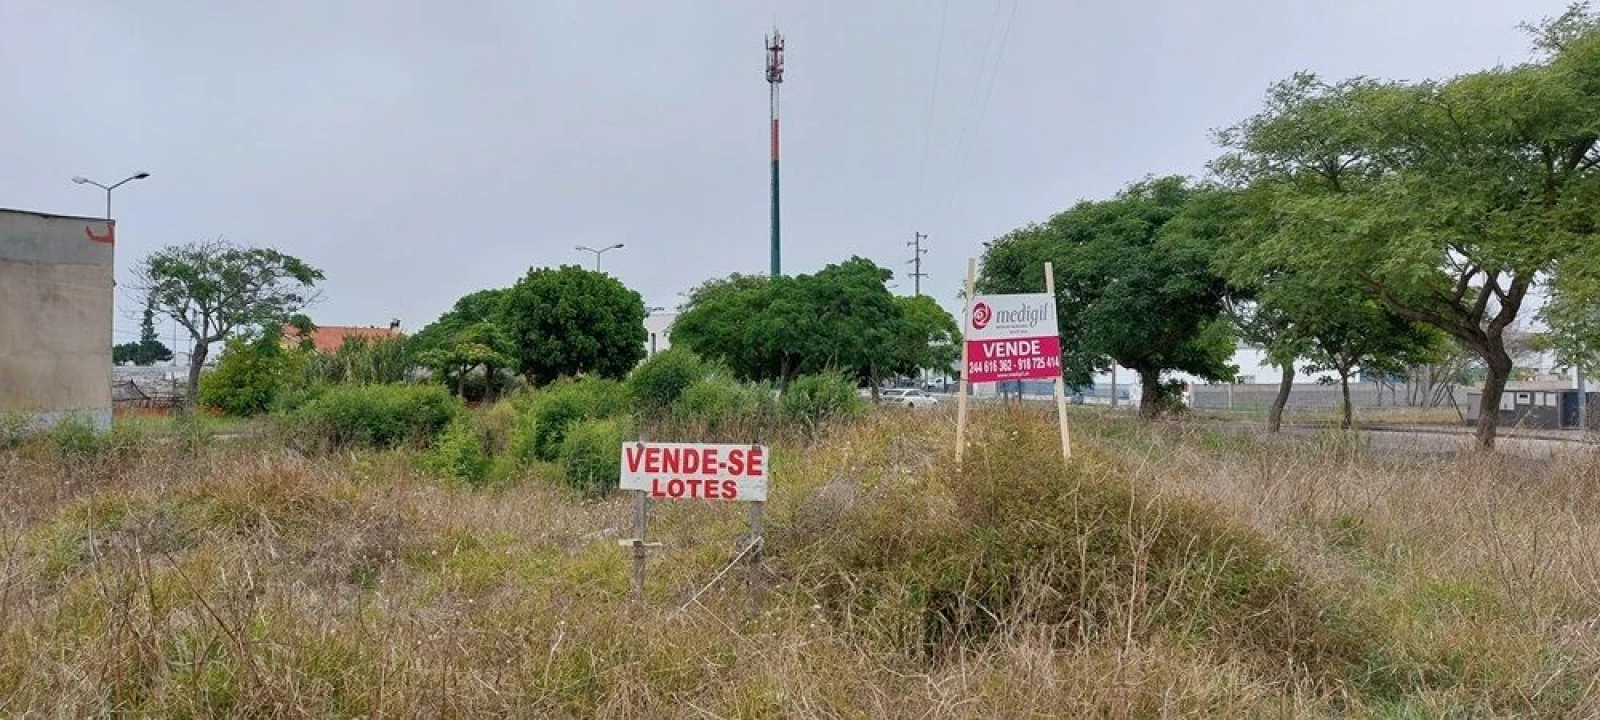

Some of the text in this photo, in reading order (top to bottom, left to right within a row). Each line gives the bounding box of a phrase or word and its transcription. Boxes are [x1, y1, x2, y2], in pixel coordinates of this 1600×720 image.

[996, 303, 1048, 327] medigil
[983, 340, 1041, 358] VENDE
[969, 361, 983, 374] 244
[984, 360, 998, 373] 616
[999, 359, 1012, 372] 362
[1018, 357, 1031, 370] 918
[1032, 356, 1046, 369] 725
[1047, 355, 1060, 368] 414
[626, 447, 763, 476] VENDE-SE
[652, 478, 737, 499] LOTES
